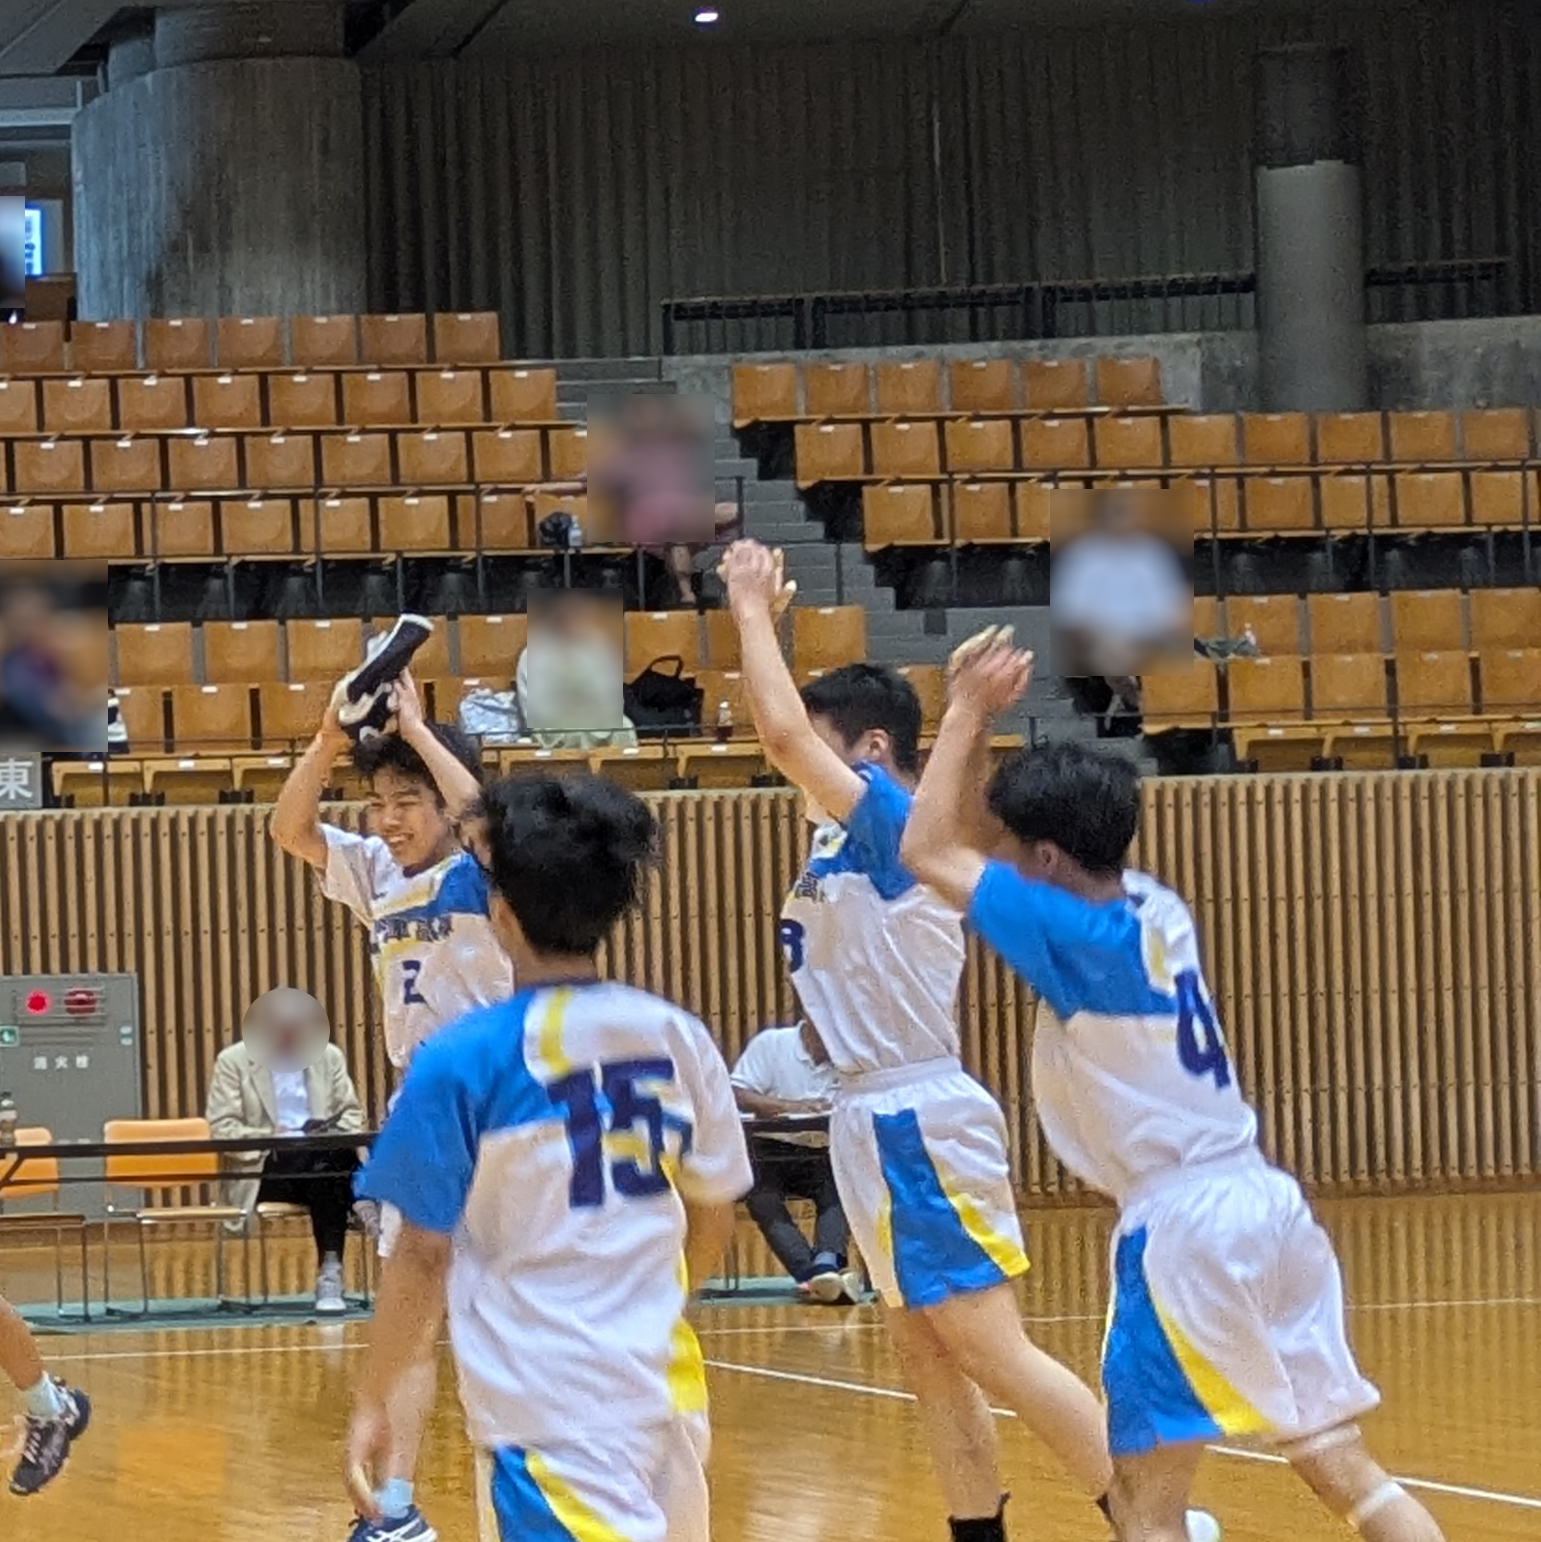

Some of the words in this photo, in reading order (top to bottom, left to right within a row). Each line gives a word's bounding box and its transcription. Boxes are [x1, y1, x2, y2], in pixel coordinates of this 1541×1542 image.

[401, 959, 429, 1005] 2
[1174, 968, 1231, 1090] 4
[545, 1056, 675, 1209] 15
